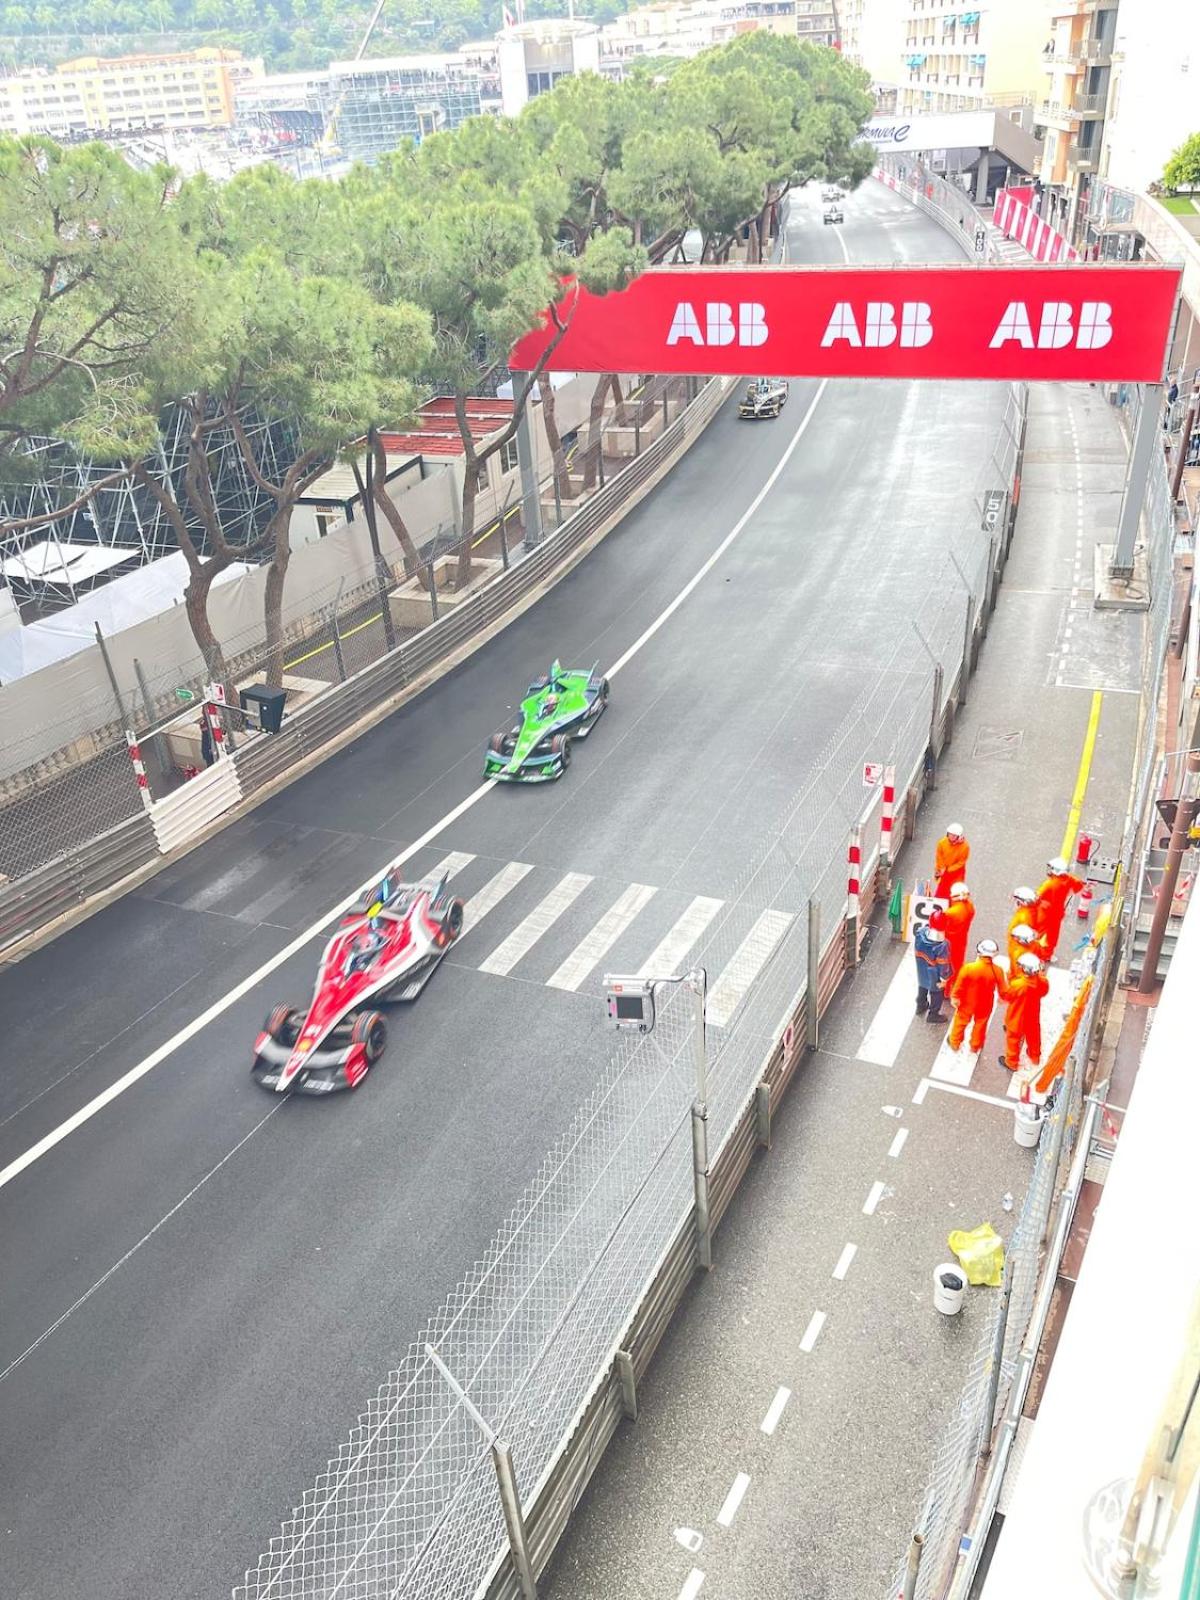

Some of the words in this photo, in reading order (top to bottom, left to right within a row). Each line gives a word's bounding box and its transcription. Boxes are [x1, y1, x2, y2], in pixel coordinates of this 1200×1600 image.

[665, 302, 769, 347] ABB
[819, 302, 934, 348] ABB
[987, 301, 1113, 349] ABB
